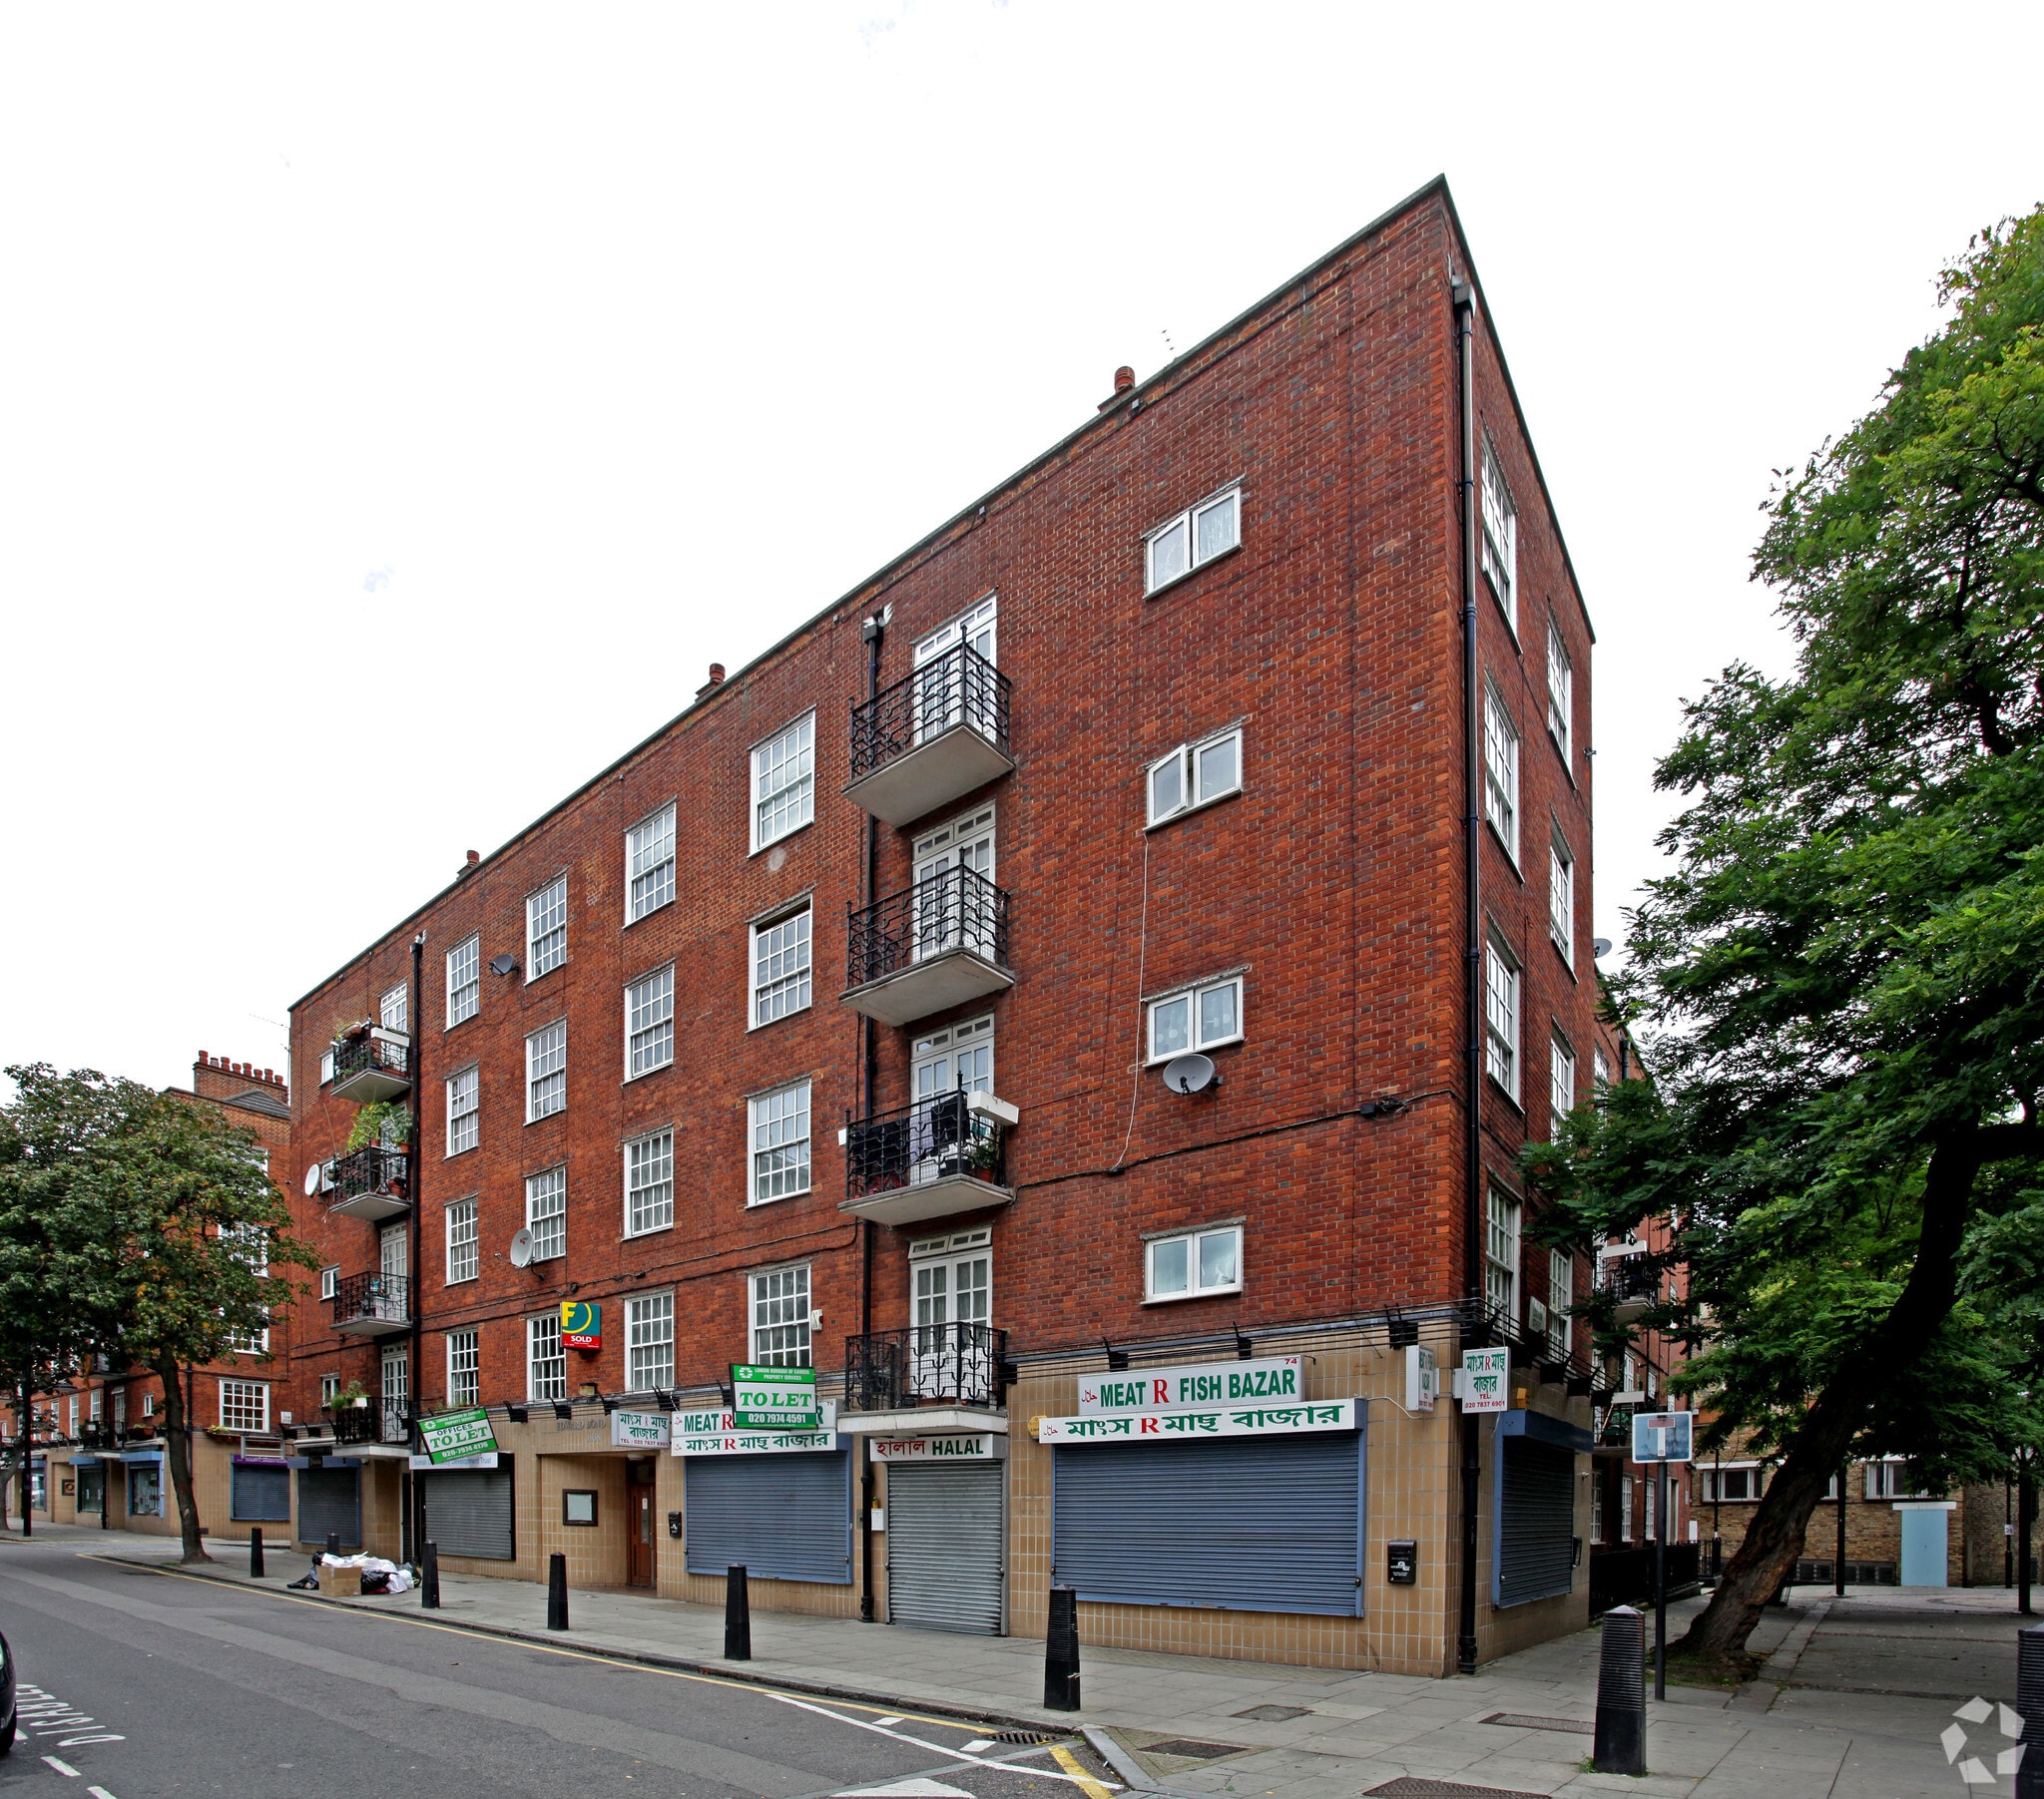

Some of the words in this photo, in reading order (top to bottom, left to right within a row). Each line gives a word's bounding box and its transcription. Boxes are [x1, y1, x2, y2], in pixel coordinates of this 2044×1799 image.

[1485, 1356, 1491, 1371] R
[1101, 1381, 1147, 1408] MEAT
[1152, 1379, 1171, 1405] R
[1180, 1375, 1223, 1403] FISH
[1229, 1369, 1296, 1399] BAZAR
[1473, 1375, 1498, 1394] বাজার
[740, 1392, 768, 1407] TO
[770, 1392, 812, 1408] LET
[619, 1413, 642, 1426] মাংস
[651, 1417, 669, 1430] মাছ
[684, 1413, 720, 1433] MEAT
[722, 1413, 736, 1431] R
[749, 1413, 766, 1423] 020
[766, 1414, 785, 1424] 7974
[786, 1414, 806, 1424] 4591
[1065, 1419, 1135, 1437] মাংস
[1140, 1417, 1161, 1435] R
[1162, 1413, 1223, 1433] মাছ
[1230, 1405, 1345, 1428] বাজার
[430, 1435, 453, 1449] TO
[455, 1426, 488, 1444] LET
[437, 1424, 473, 1436] OFFICES
[629, 1427, 660, 1440] বাজার
[686, 1438, 723, 1451] মাংস
[724, 1438, 737, 1450] R
[739, 1436, 770, 1450] মাছ
[771, 1433, 830, 1448] বাজার
[875, 1440, 926, 1457] হালাল
[932, 1439, 984, 1456] HALAL
